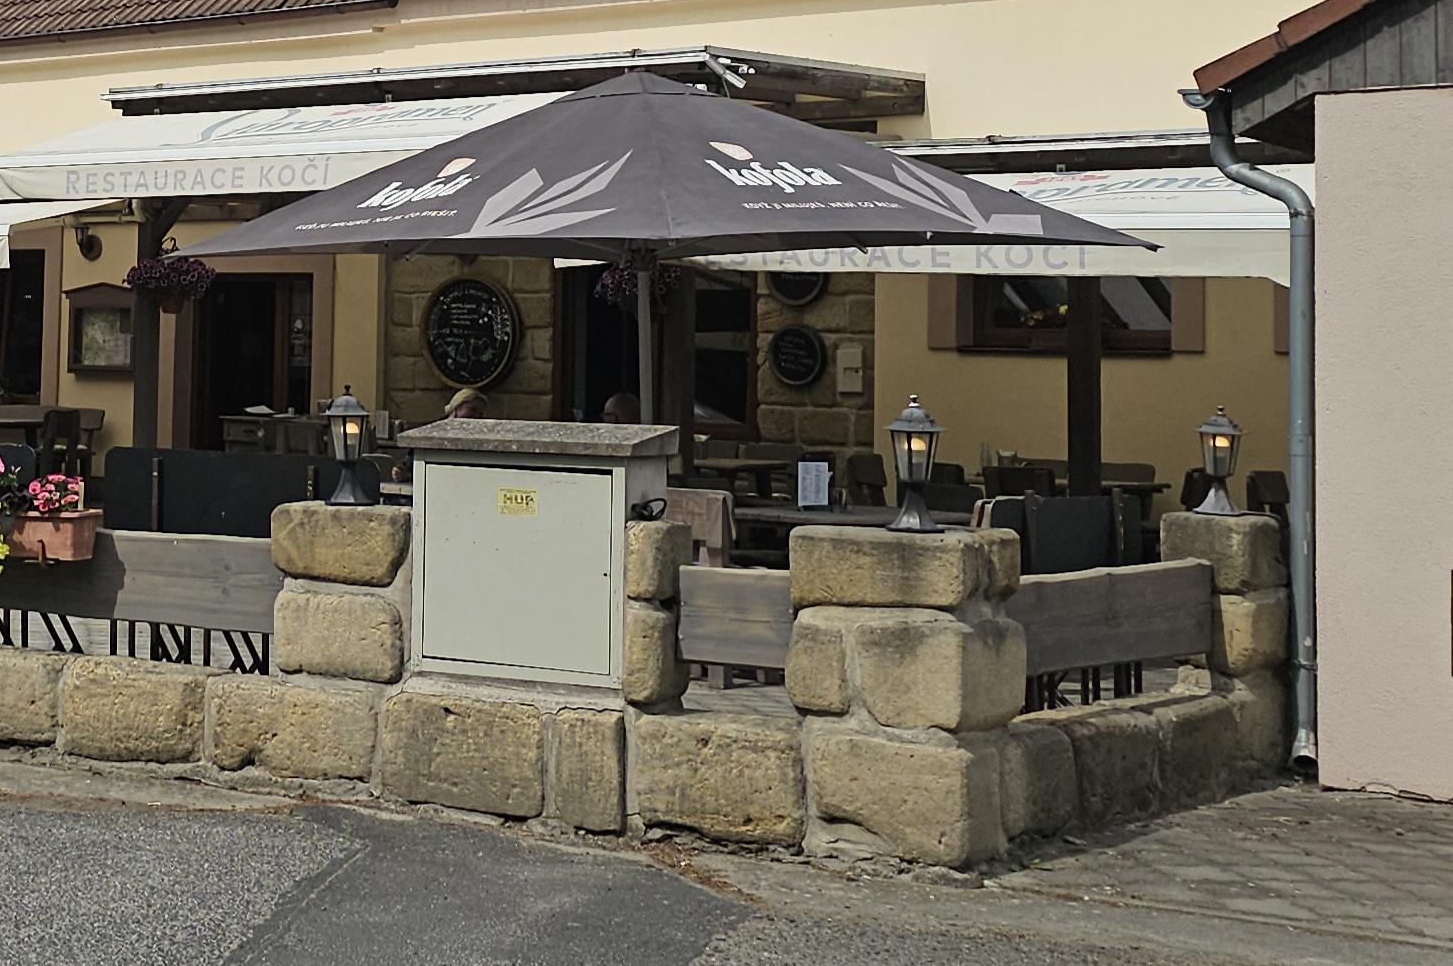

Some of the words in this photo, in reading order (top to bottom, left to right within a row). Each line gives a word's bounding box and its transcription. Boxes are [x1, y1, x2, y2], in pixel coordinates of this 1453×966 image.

[66, 166, 246, 195] RESTAURACE
[259, 156, 333, 188] KOČÍ
[356, 173, 474, 212] kofola
[704, 159, 843, 194] kofola
